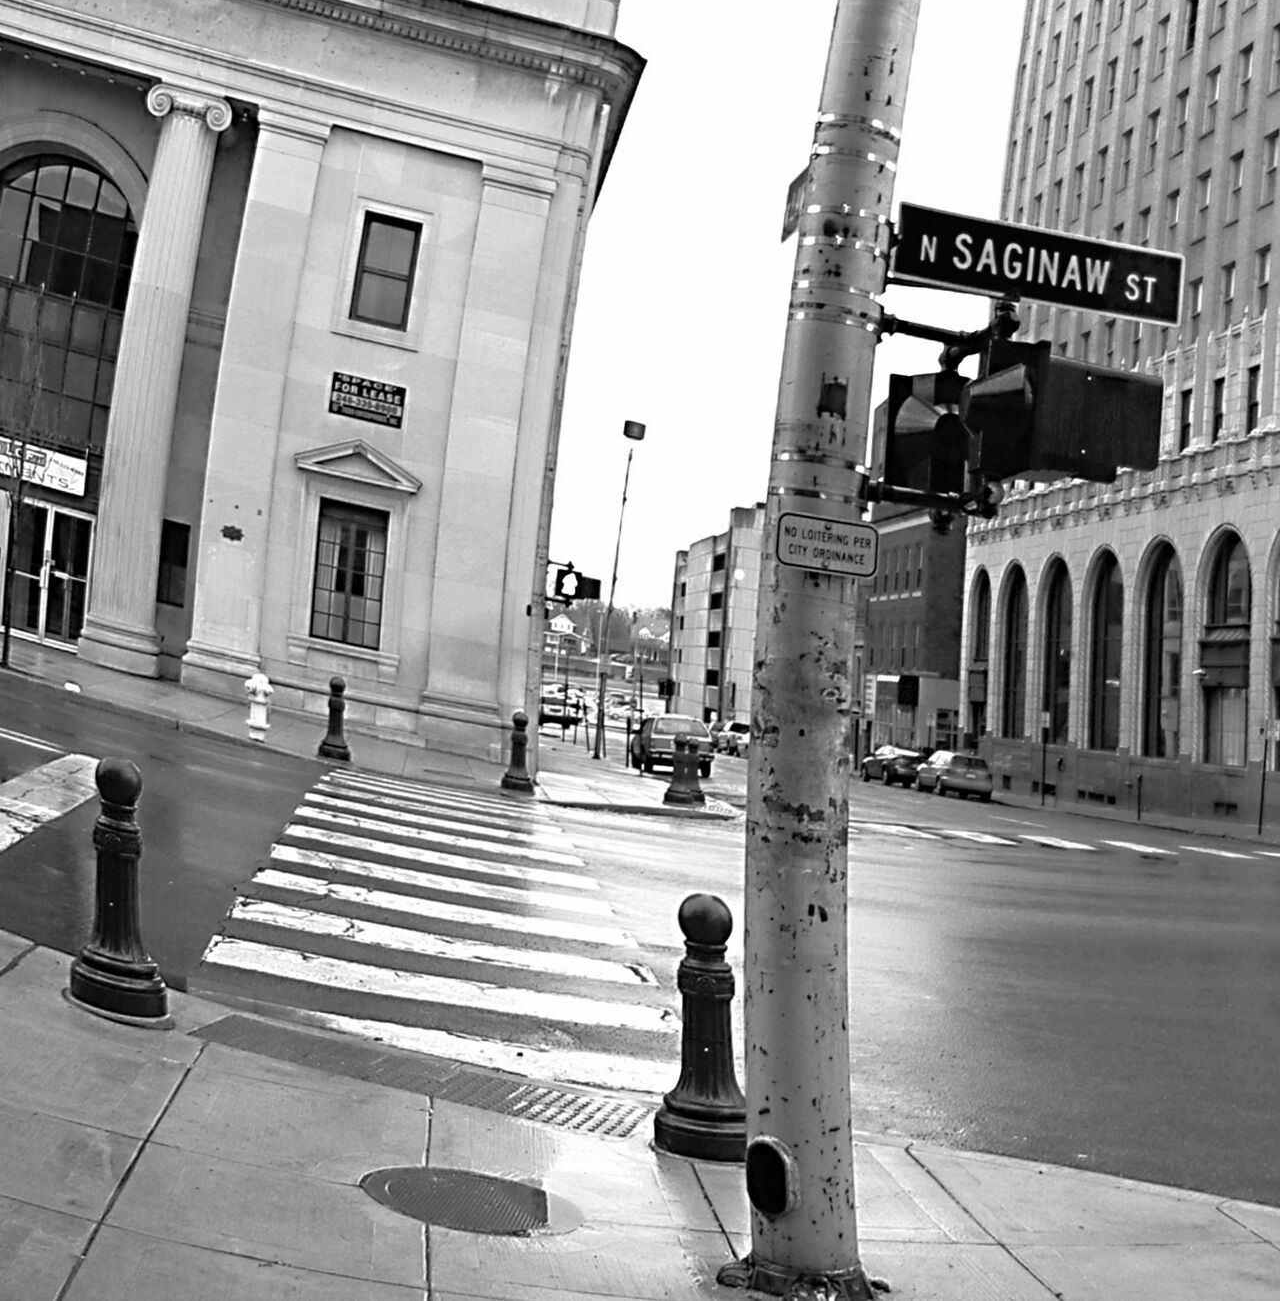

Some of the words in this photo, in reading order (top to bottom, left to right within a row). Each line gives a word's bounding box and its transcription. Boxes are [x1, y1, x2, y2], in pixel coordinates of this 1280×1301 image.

[920, 234, 938, 263] N
[952, 233, 1110, 295] SAGINAW
[1125, 274, 1157, 303] ST
[335, 381, 359, 395] FOR
[362, 387, 401, 405] LEASE
[784, 526, 797, 538] NO
[801, 529, 849, 546] LOITERING
[853, 536, 872, 549] PER
[788, 543, 808, 556] CITY
[813, 547, 865, 565] ORDINANCE
